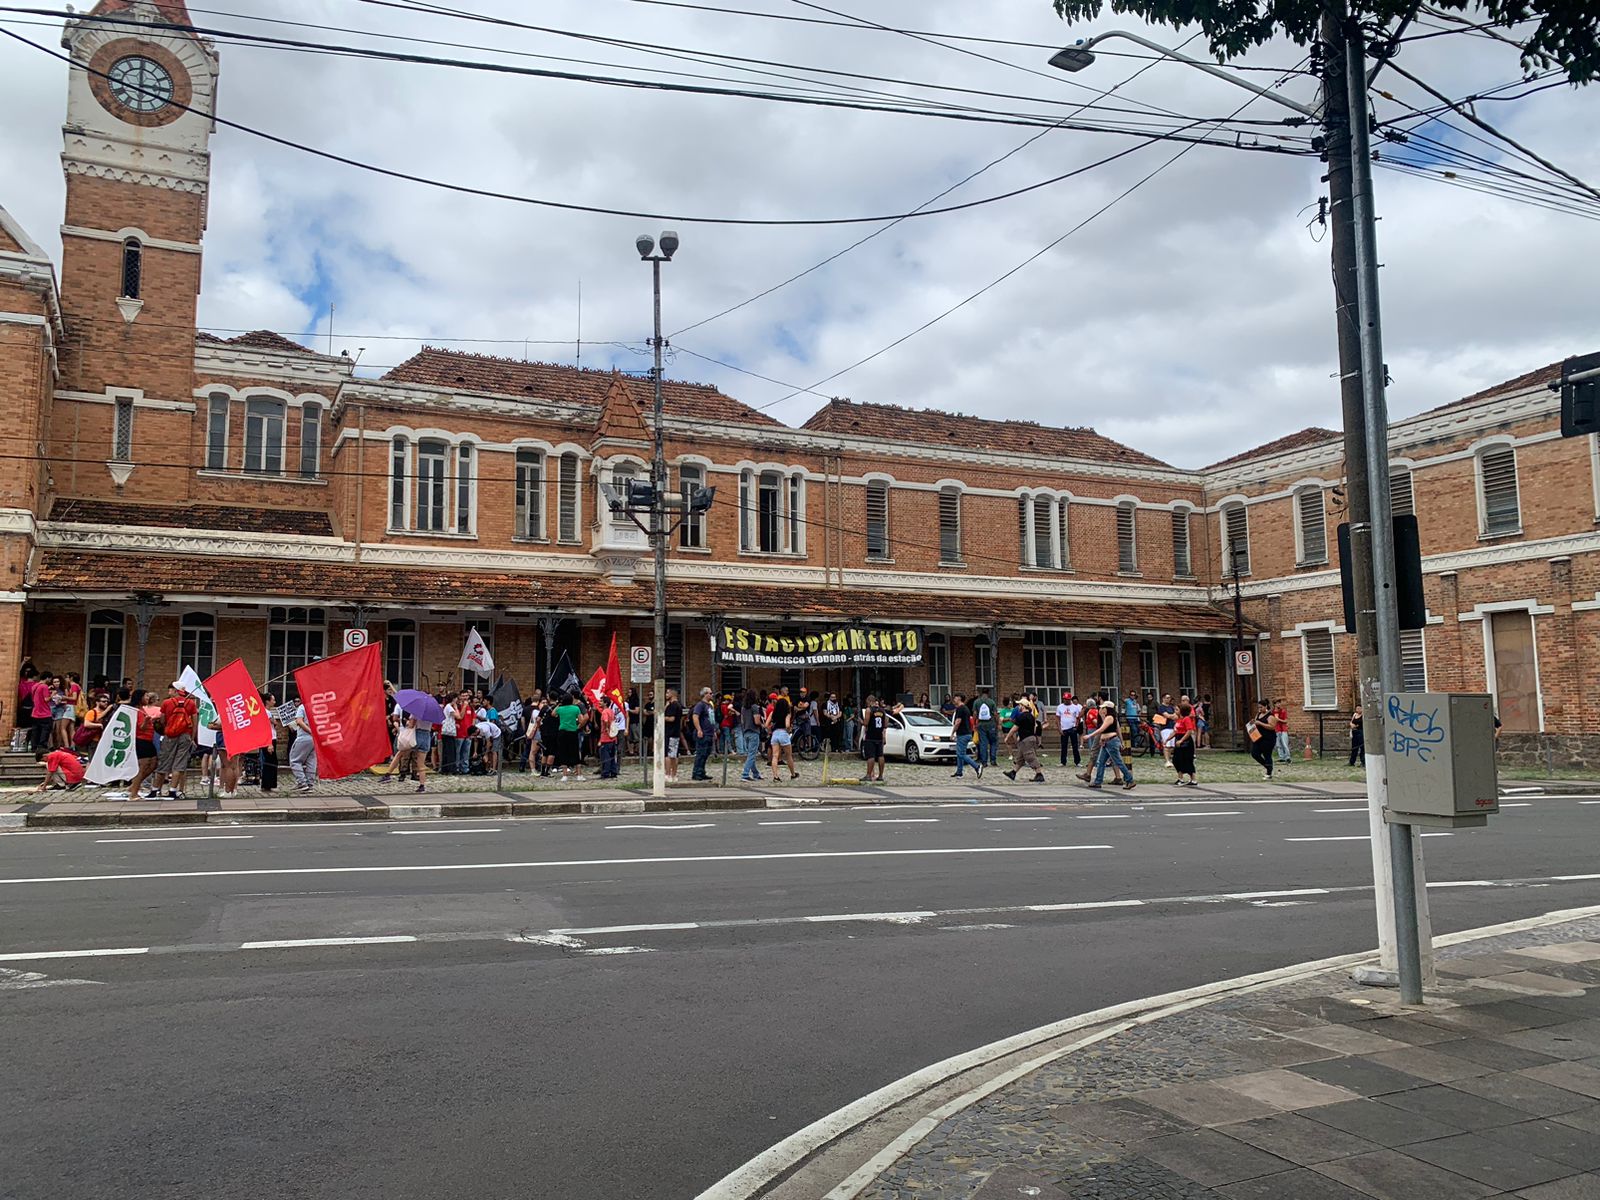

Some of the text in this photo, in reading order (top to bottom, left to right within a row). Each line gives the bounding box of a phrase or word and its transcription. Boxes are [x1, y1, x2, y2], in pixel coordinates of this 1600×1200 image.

[352, 633, 360, 644] E
[724, 626, 918, 653] ESTACIONAMENTO
[638, 650, 645, 661] E
[721, 651, 734, 661] NA
[735, 653, 754, 663] RUA
[755, 654, 805, 664] FRANCISCO
[806, 654, 847, 664] TEODORO
[853, 653, 876, 662] atrás
[876, 654, 887, 662] da
[888, 654, 922, 664] estação
[229, 693, 251, 729] PCdoB
[1389, 730, 1432, 763] BPC
